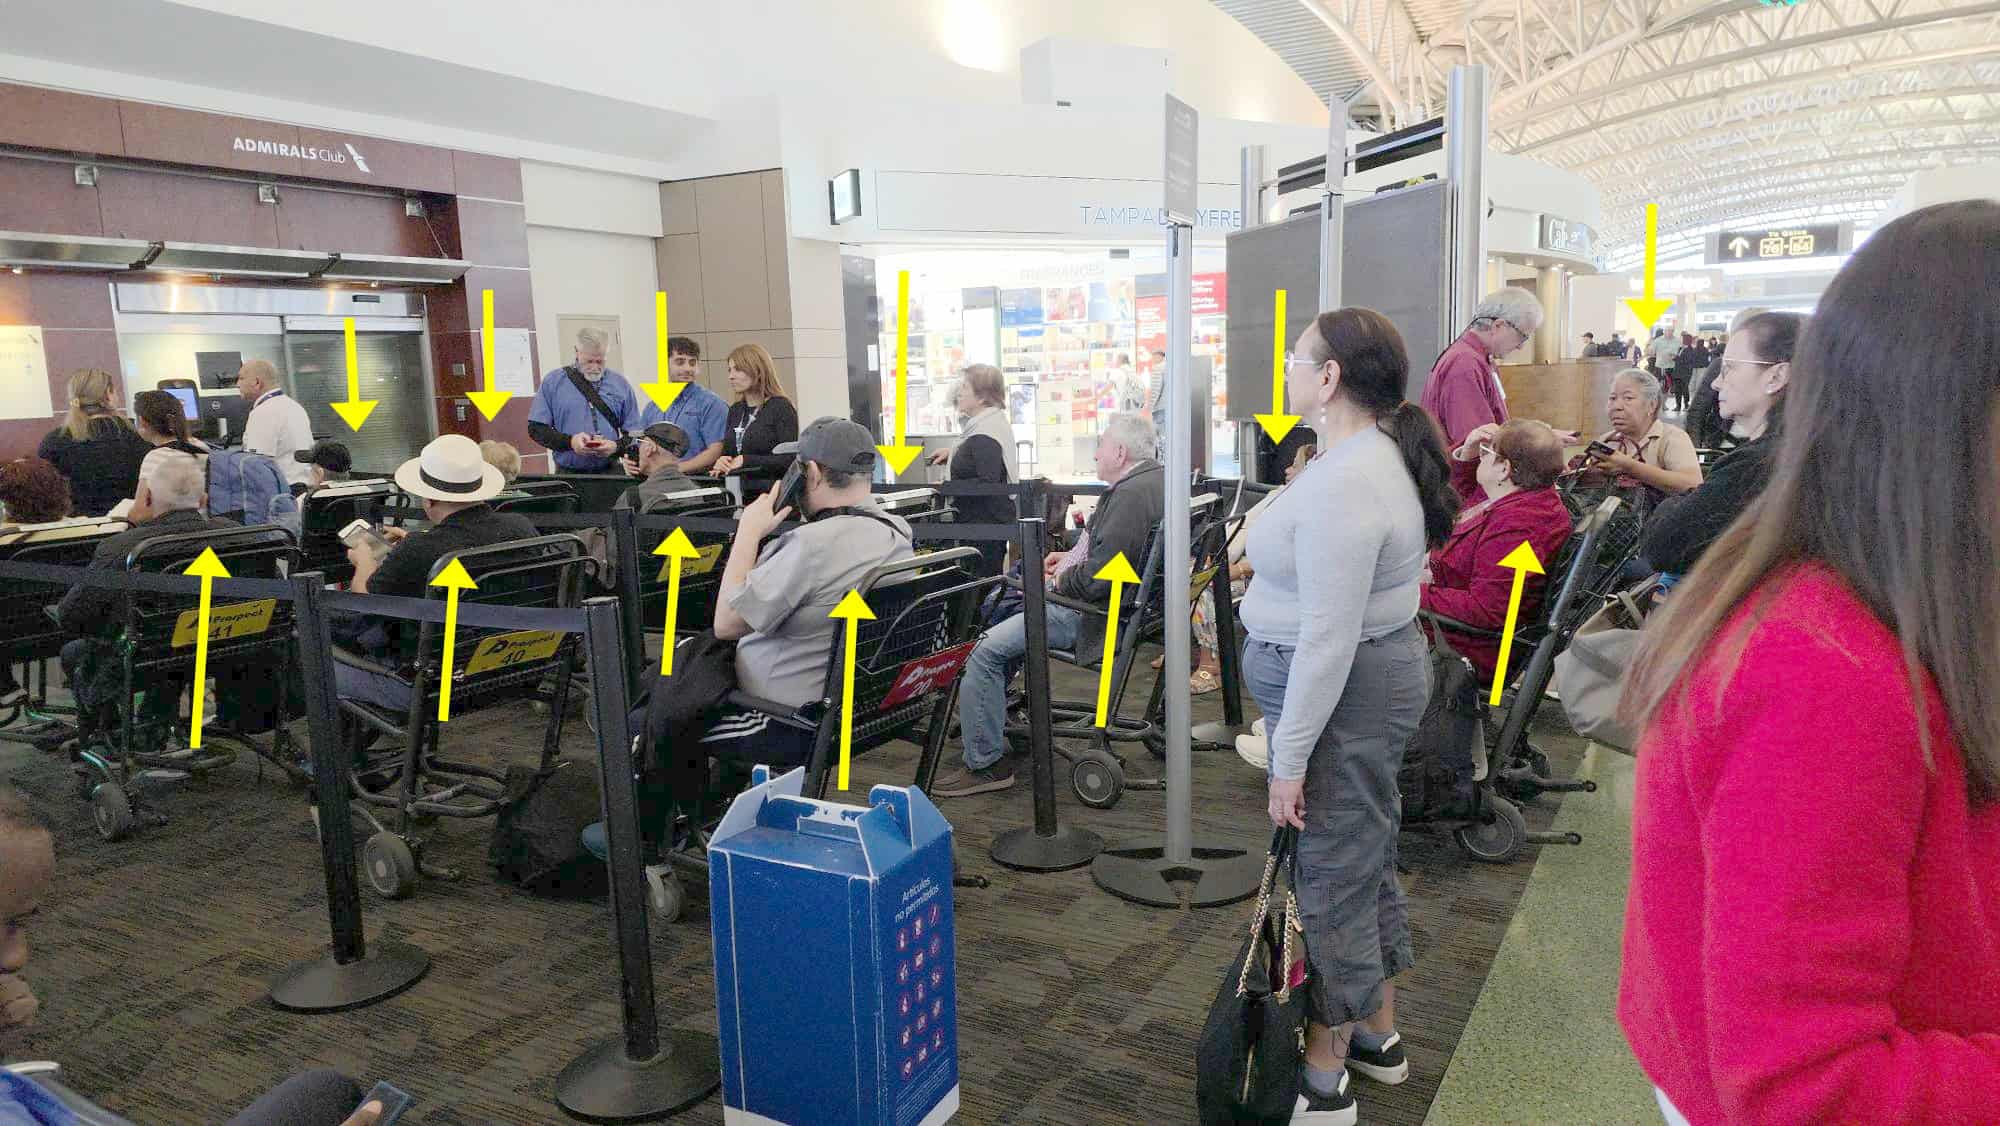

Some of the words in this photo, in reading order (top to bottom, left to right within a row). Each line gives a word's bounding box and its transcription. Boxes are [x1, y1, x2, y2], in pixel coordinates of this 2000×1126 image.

[233, 137, 317, 160] ADMIRALS
[319, 149, 346, 164] Club
[209, 624, 233, 639] 41
[896, 911, 905, 922] no
